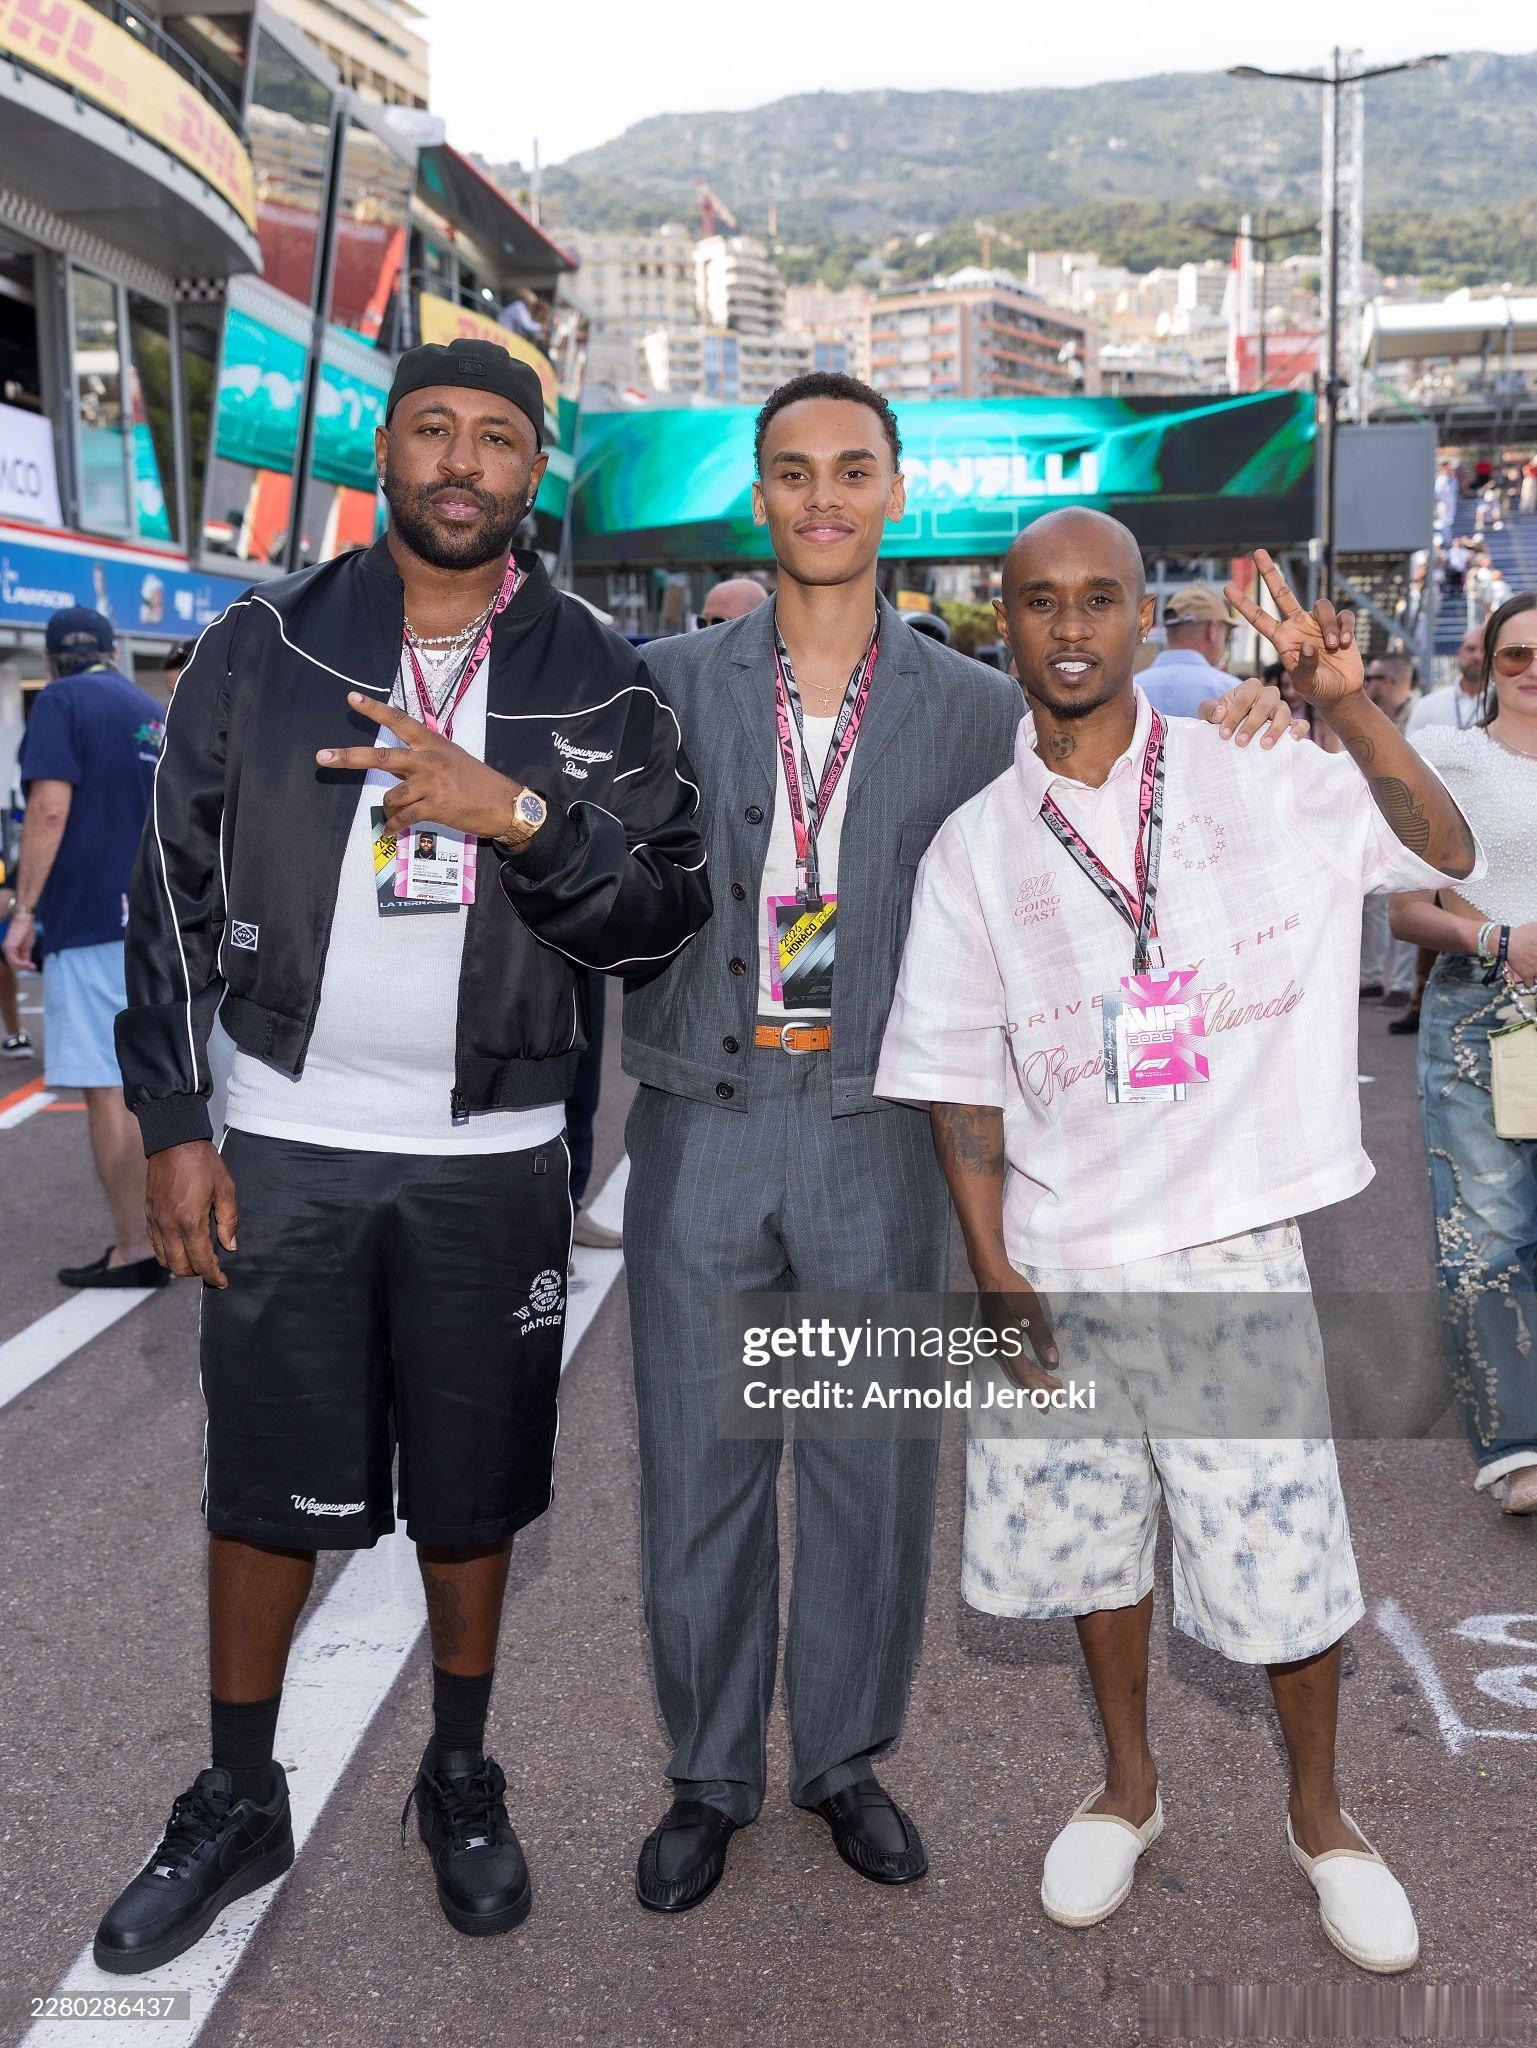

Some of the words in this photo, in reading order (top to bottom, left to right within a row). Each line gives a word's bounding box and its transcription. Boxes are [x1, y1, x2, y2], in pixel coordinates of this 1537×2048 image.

[0, 0, 105, 84] HL
[837, 710, 852, 734] 2026
[1014, 894, 1061, 917] GOING
[1023, 906, 1059, 926] FAST
[780, 925, 803, 949] 2026
[786, 923, 818, 957] MONACO
[1230, 913, 1300, 956] THE
[1127, 1003, 1191, 1033] VIP
[1128, 1032, 1175, 1046] 2026
